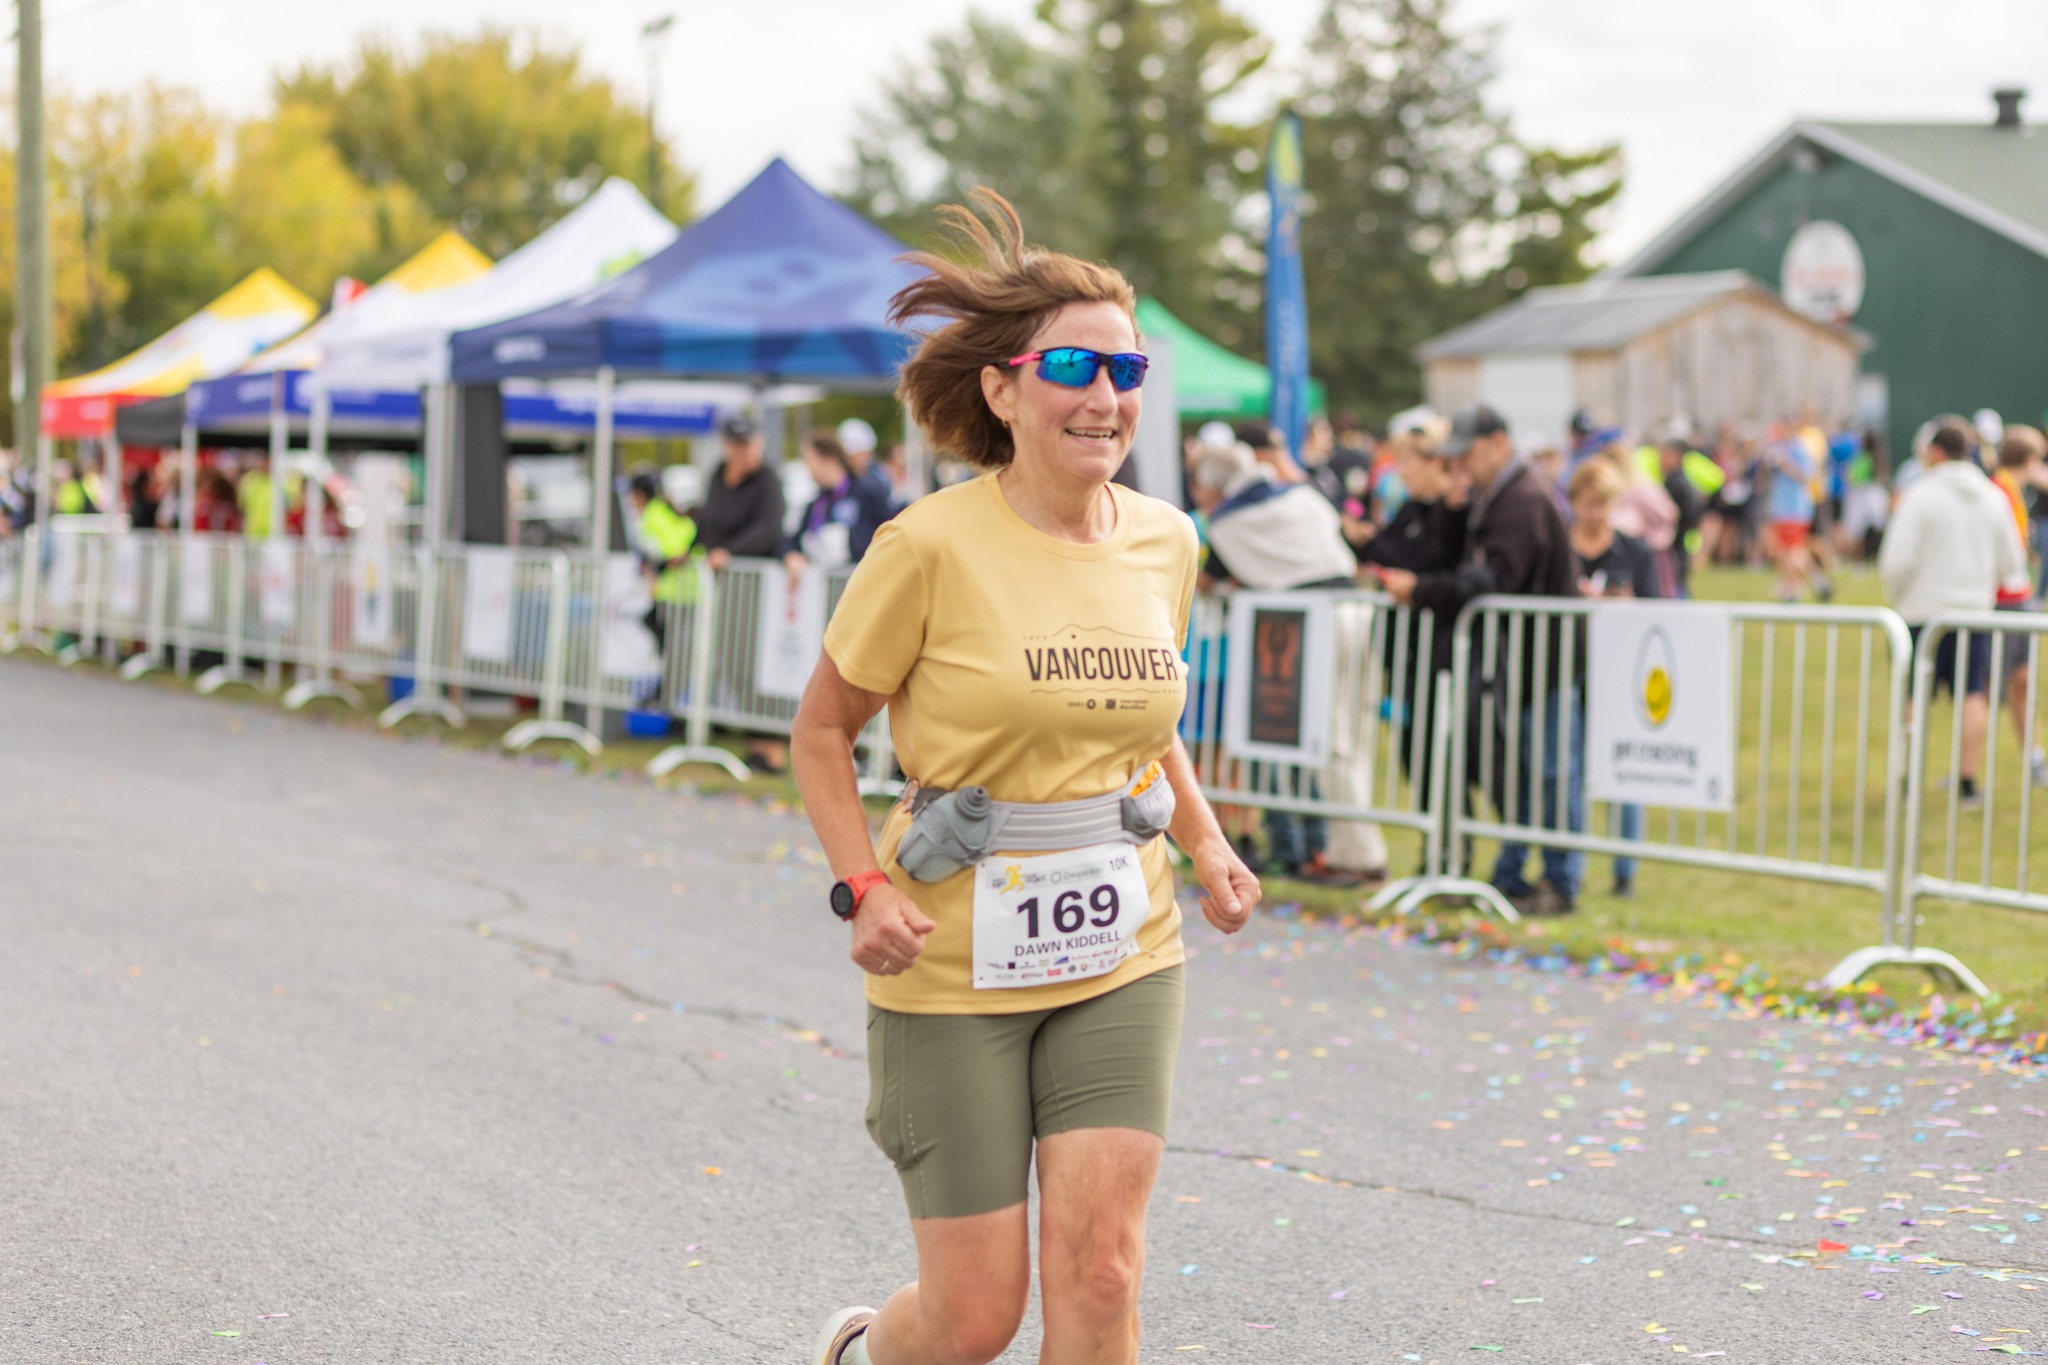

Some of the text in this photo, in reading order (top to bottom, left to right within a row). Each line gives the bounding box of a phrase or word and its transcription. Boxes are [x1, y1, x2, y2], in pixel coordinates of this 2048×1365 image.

[1024, 647, 1179, 681] VANCOUVER
[1109, 855, 1129, 872] 10K
[1018, 884, 1119, 938] 169
[1014, 930, 1121, 957] DAWN KIDDELL
